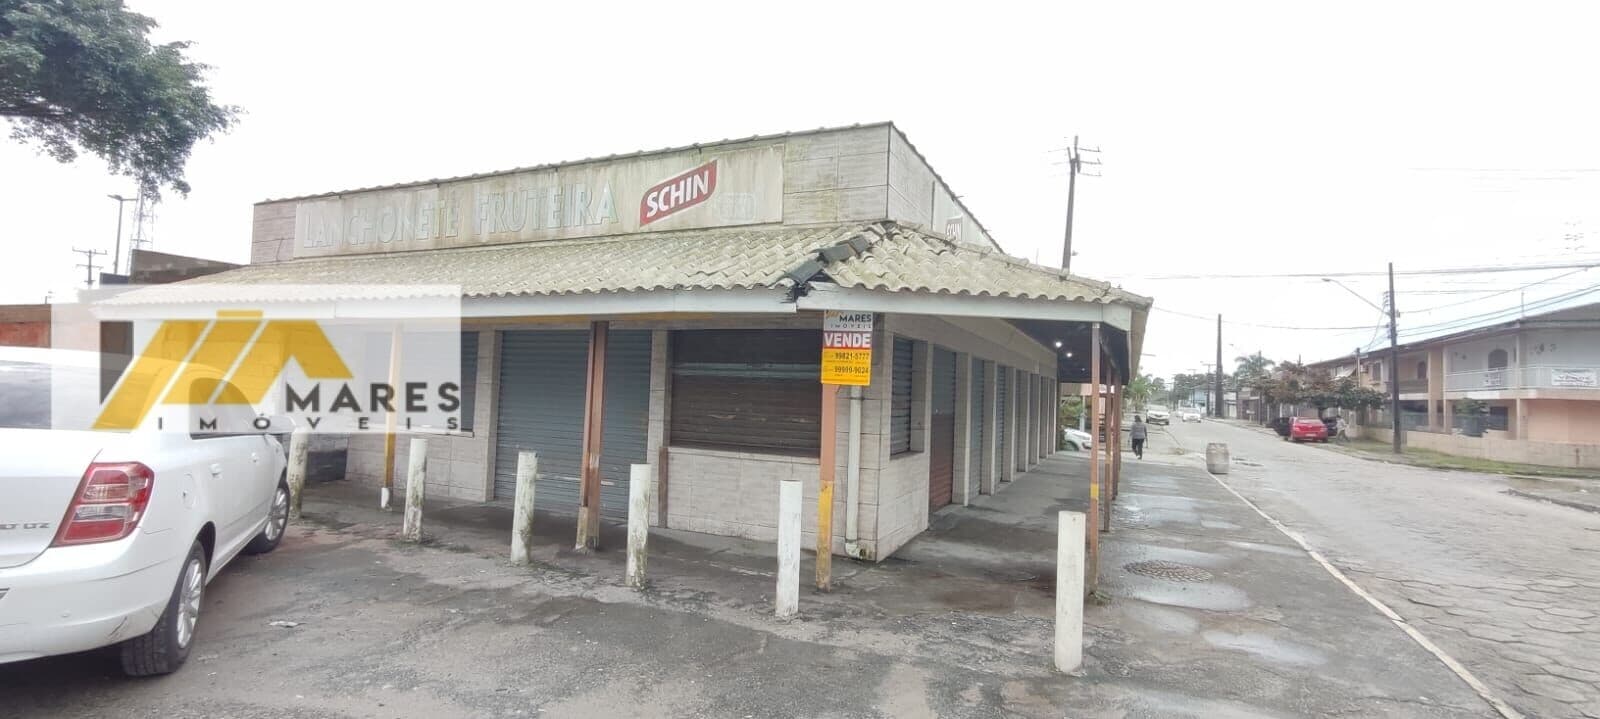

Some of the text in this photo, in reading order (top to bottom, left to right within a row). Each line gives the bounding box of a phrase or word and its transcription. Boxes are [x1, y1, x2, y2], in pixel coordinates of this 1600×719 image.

[646, 170, 710, 218] SCHIN
[303, 181, 619, 248] LANCHONETE FRUTEIRA
[840, 314, 871, 322] MARES
[824, 332, 871, 347] VENDE
